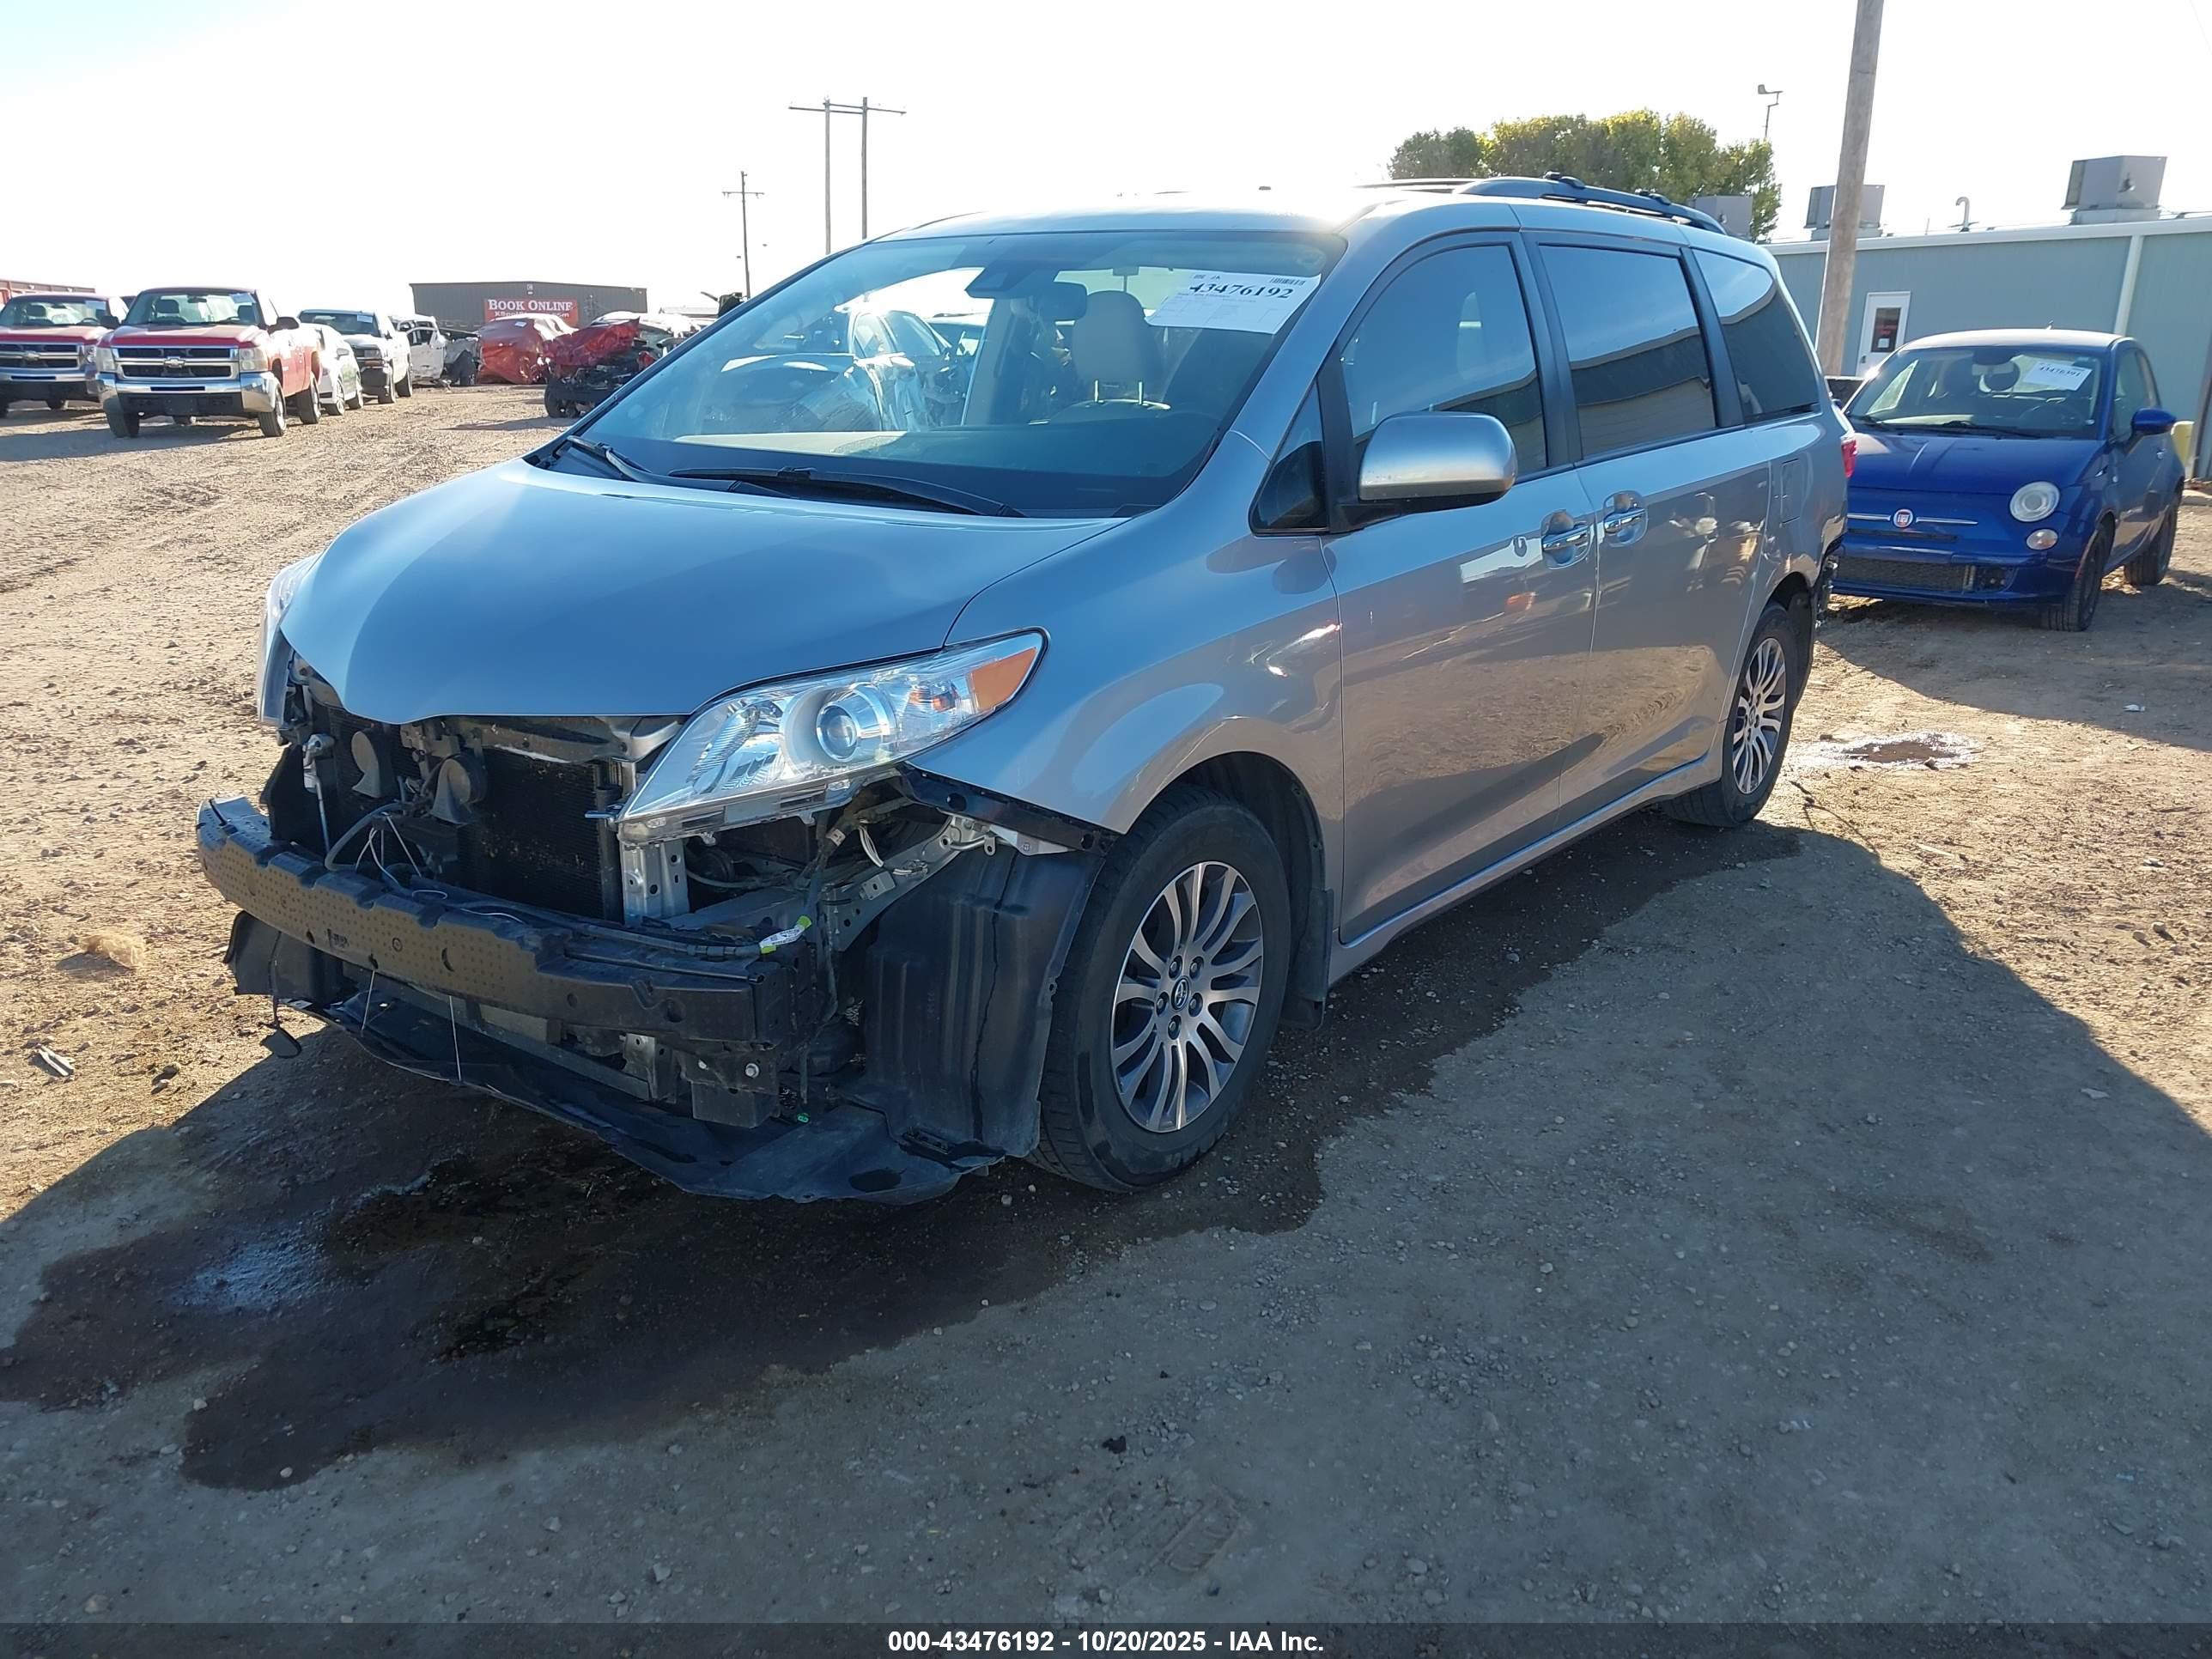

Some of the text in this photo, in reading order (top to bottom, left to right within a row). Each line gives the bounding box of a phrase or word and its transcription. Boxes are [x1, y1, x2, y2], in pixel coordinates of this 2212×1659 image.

[1189, 283, 1294, 299] 43476192
[488, 299, 574, 311] BOOK ONLINE
